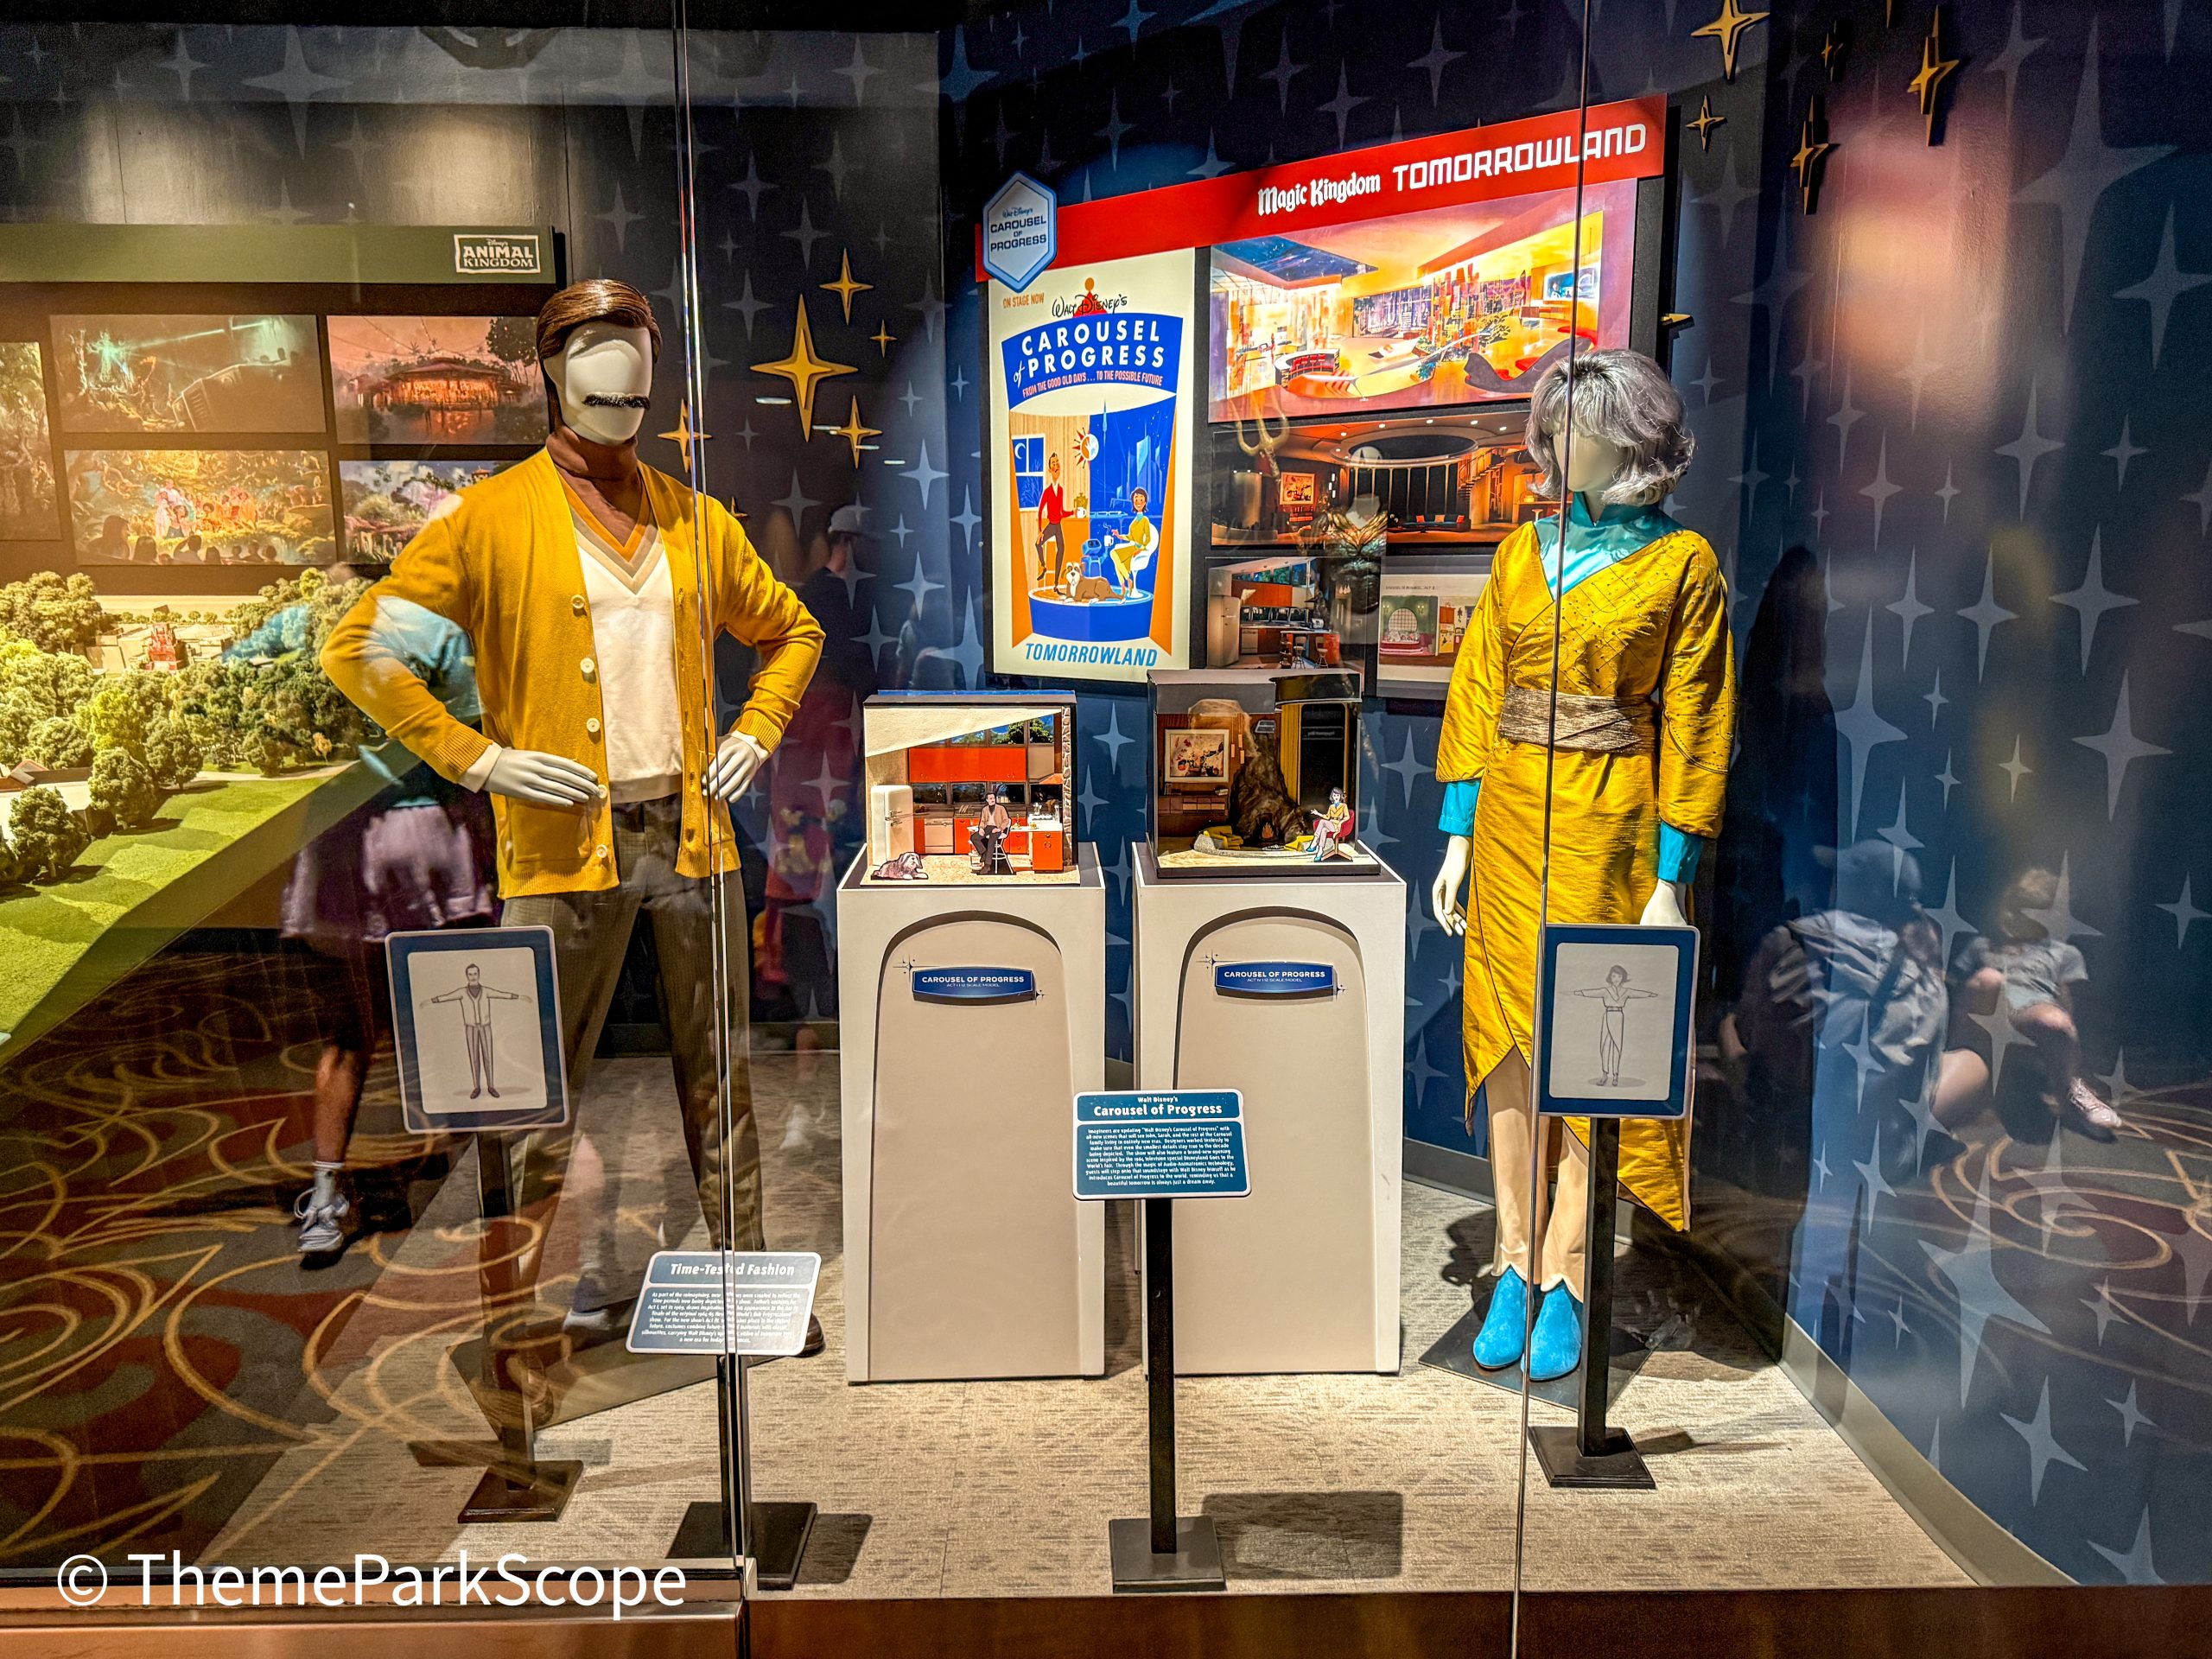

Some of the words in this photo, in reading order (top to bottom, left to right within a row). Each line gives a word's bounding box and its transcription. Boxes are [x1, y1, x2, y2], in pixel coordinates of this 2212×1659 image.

[1258, 184, 1306, 216] Magic
[1311, 173, 1381, 207] Kingdom
[1393, 124, 1646, 192] TOMORROWLAND
[990, 215, 1046, 233] CAROUSEL
[463, 246, 533, 258] ANIMAL
[990, 234, 1046, 252] PROGRESS
[464, 258, 534, 267] KINGDOM
[1003, 298, 1011, 308] ON
[1012, 296, 1029, 308] STAGE
[1031, 293, 1045, 305] NOW
[1052, 299, 1077, 317] Walt
[1075, 294, 1128, 315] Disney's
[1021, 320, 1160, 356] CAROUSEL
[1013, 360, 1027, 388] of
[1028, 345, 1164, 378] PROGRESS
[1022, 384, 1037, 398] FROM
[1037, 381, 1046, 392] THE
[1047, 377, 1061, 389] GOOD
[1062, 375, 1072, 385] OLD
[1096, 371, 1103, 380] TO
[1104, 371, 1114, 380] THE
[1115, 371, 1141, 382] POSSIBLE
[1142, 372, 1163, 386] FUTURE
[1026, 643, 1158, 666] TOMORROWLAND
[1154, 1096, 1179, 1104] Disney's
[1094, 1105, 1147, 1116] Carousel
[1152, 1104, 1164, 1115] of
[1167, 1104, 1223, 1116] Progress
[671, 1263, 745, 1275] Time-Tested
[747, 1263, 795, 1275] Fashion
